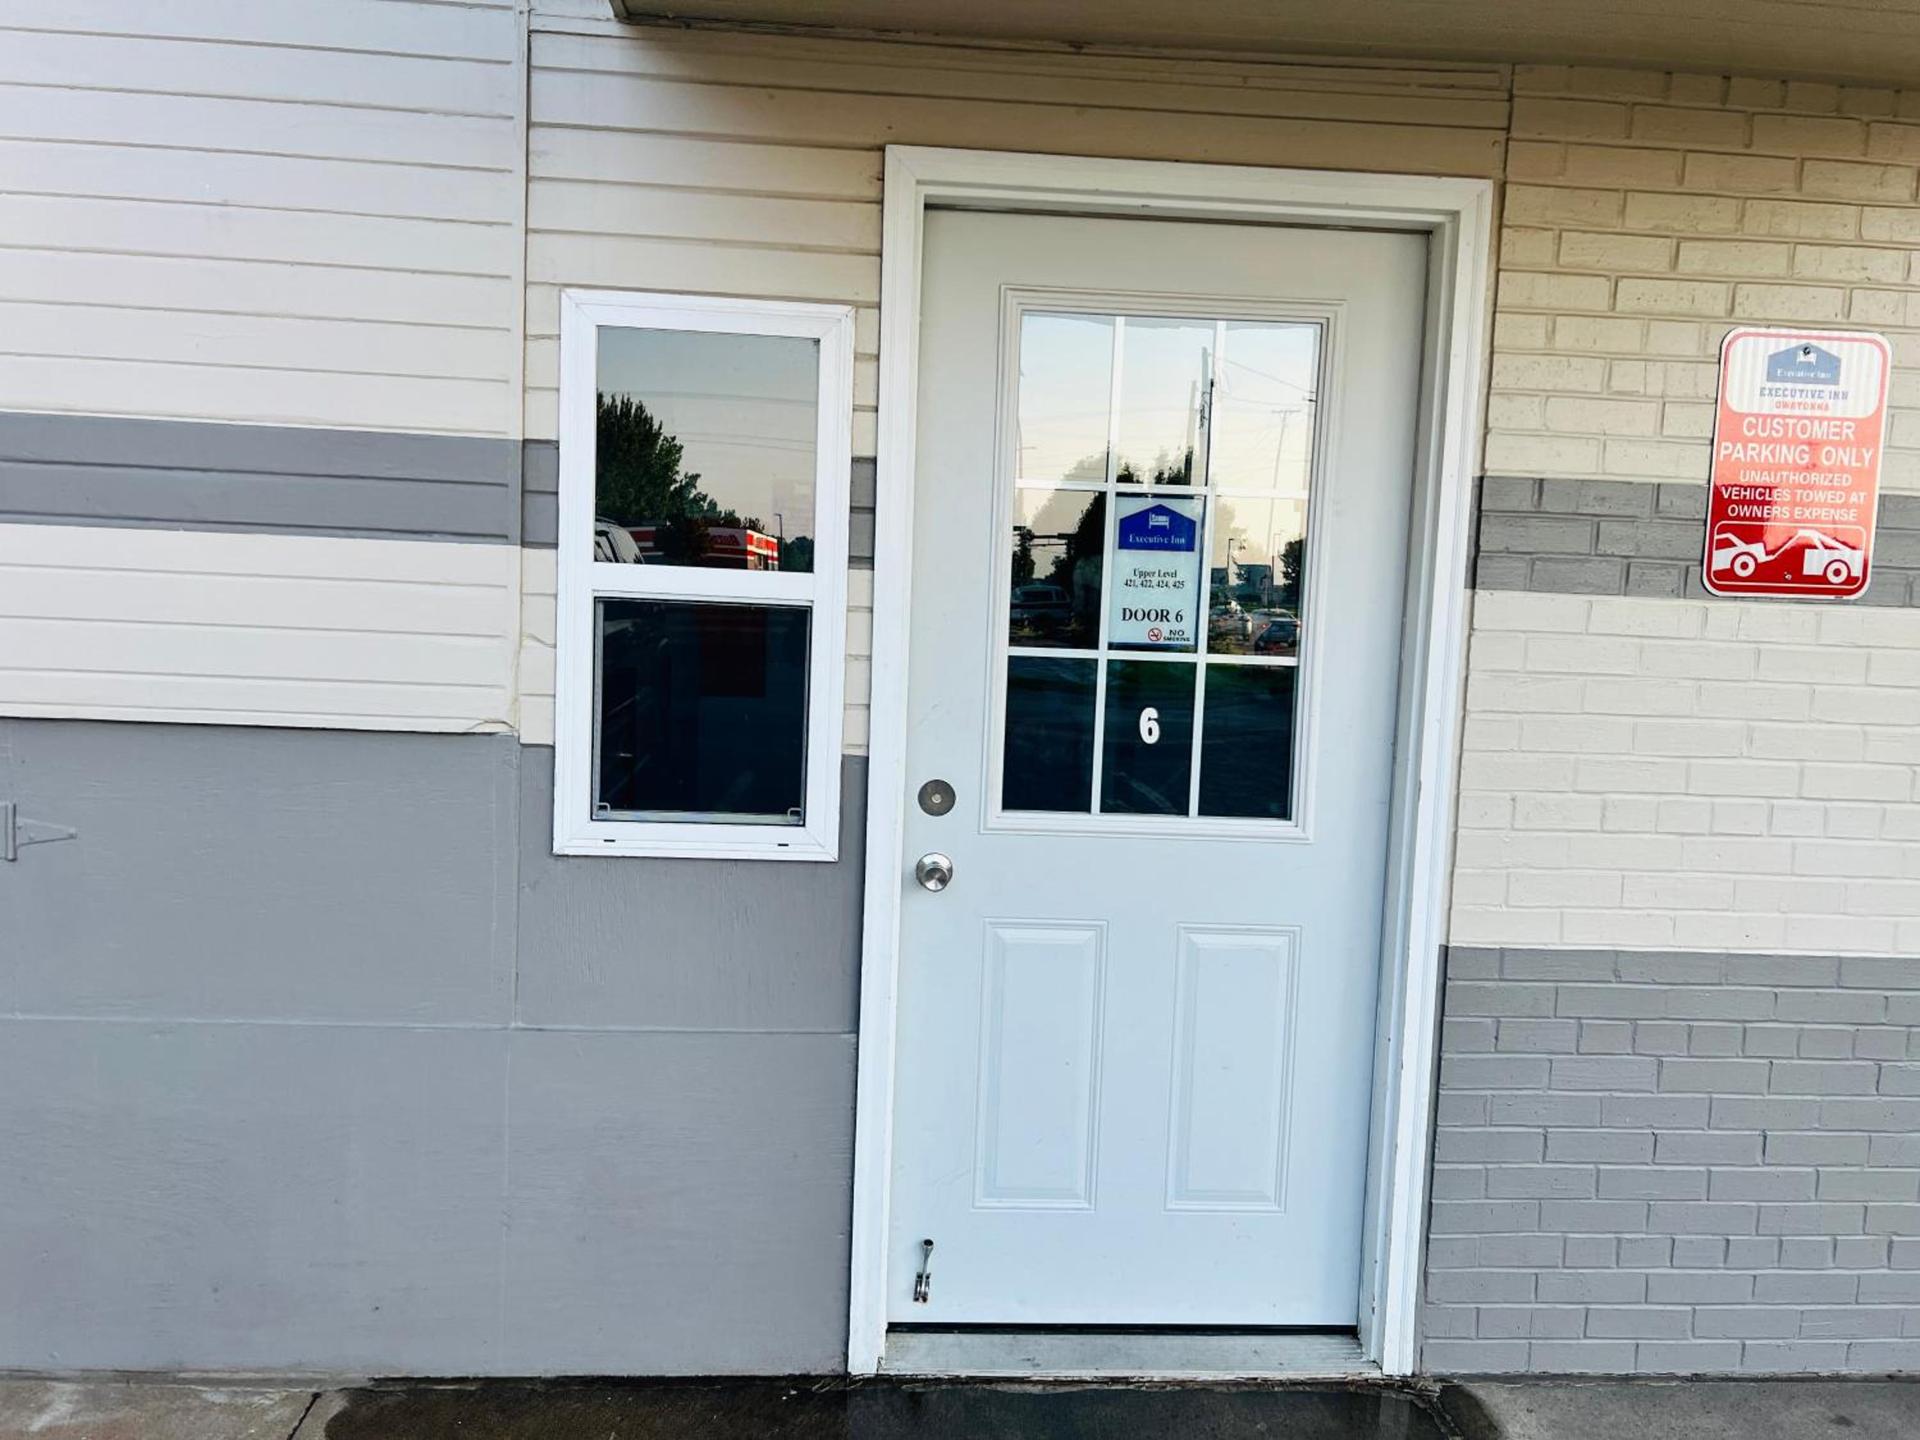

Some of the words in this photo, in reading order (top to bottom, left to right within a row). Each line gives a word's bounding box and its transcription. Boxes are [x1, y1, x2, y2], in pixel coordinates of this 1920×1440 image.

[1760, 387, 1825, 399] EXECUTIVE
[1829, 390, 1849, 401] INN
[1743, 417, 1856, 440] CUSTOMER
[1720, 442, 1810, 464] PARKING
[1822, 446, 1873, 467] ONLY
[1740, 470, 1853, 487] UNAUTHORIZED
[1722, 486, 1791, 502] VEHICLES
[1795, 489, 1846, 503] TOWED
[1850, 491, 1867, 504] AT
[1727, 504, 1790, 519] OWNERS
[1794, 506, 1858, 521] EXPENSE
[1129, 533, 1168, 544] Executive
[1171, 535, 1186, 545] Inn
[1133, 568, 1155, 578] Upper
[1158, 569, 1177, 578] Level
[1121, 607, 1170, 622] DOOR
[1175, 609, 1183, 622] 6
[1140, 707, 1160, 744] 6
